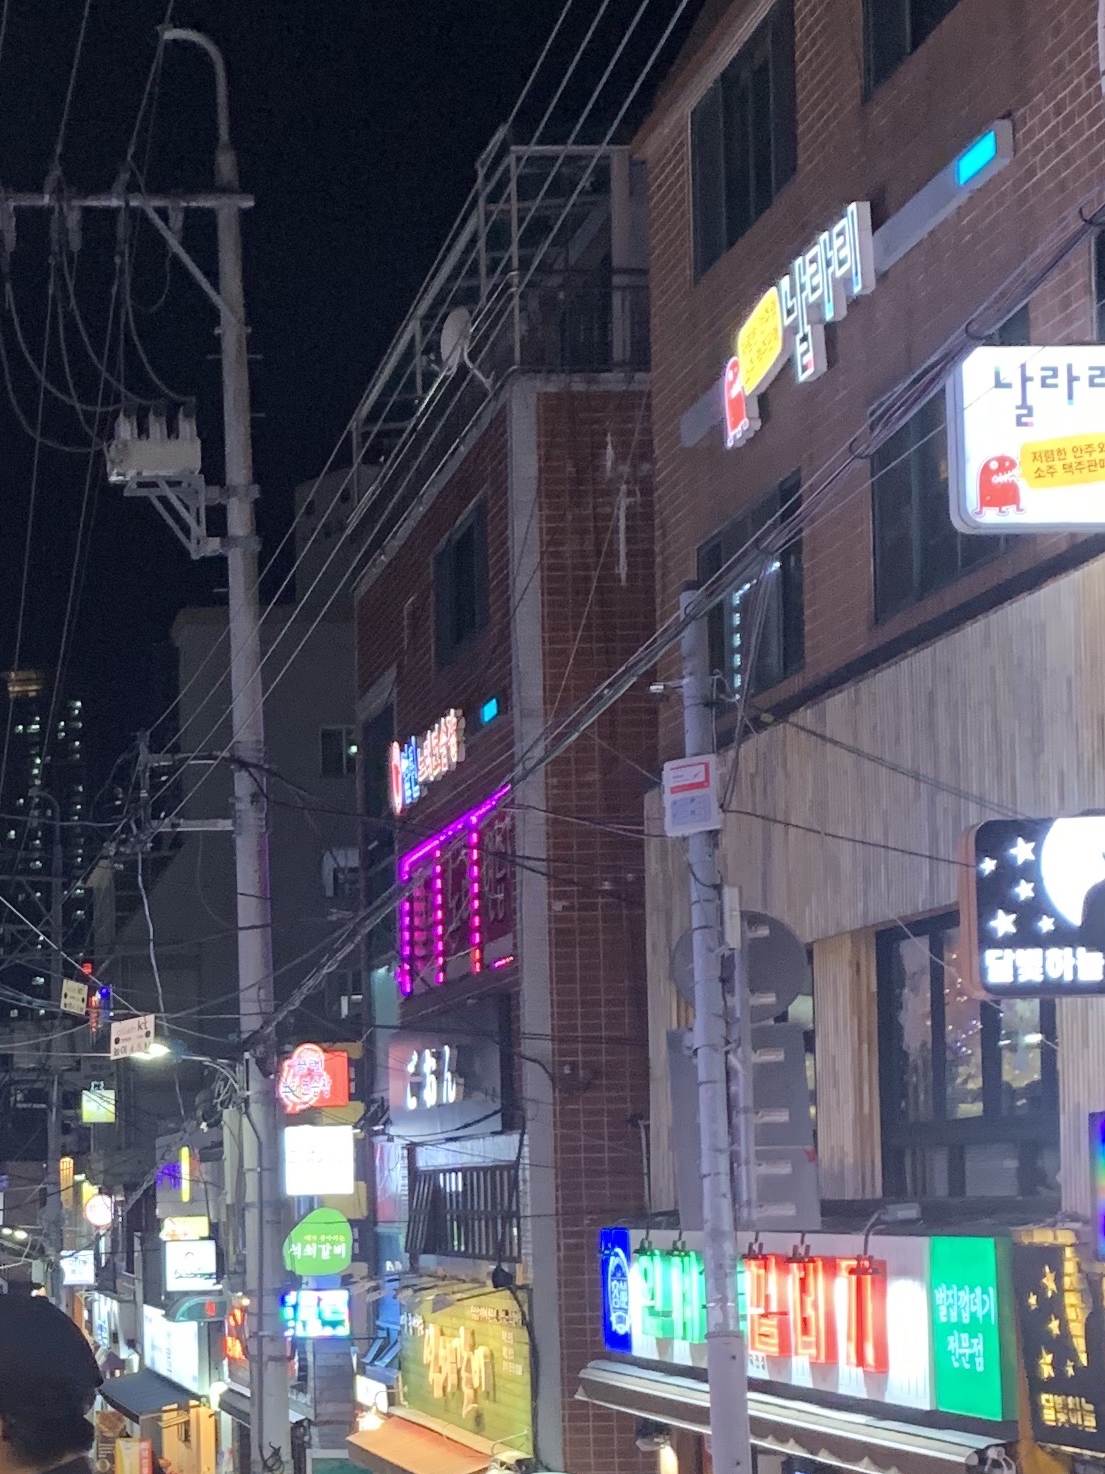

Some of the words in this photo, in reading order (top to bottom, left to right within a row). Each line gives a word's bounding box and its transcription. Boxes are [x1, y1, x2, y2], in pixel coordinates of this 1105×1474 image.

[1031, 448, 1068, 465] 저렴한
[1034, 464, 1059, 480] 소주
[985, 946, 1104, 983] 달빛하늘
[946, 1329, 985, 1372] 전문점
